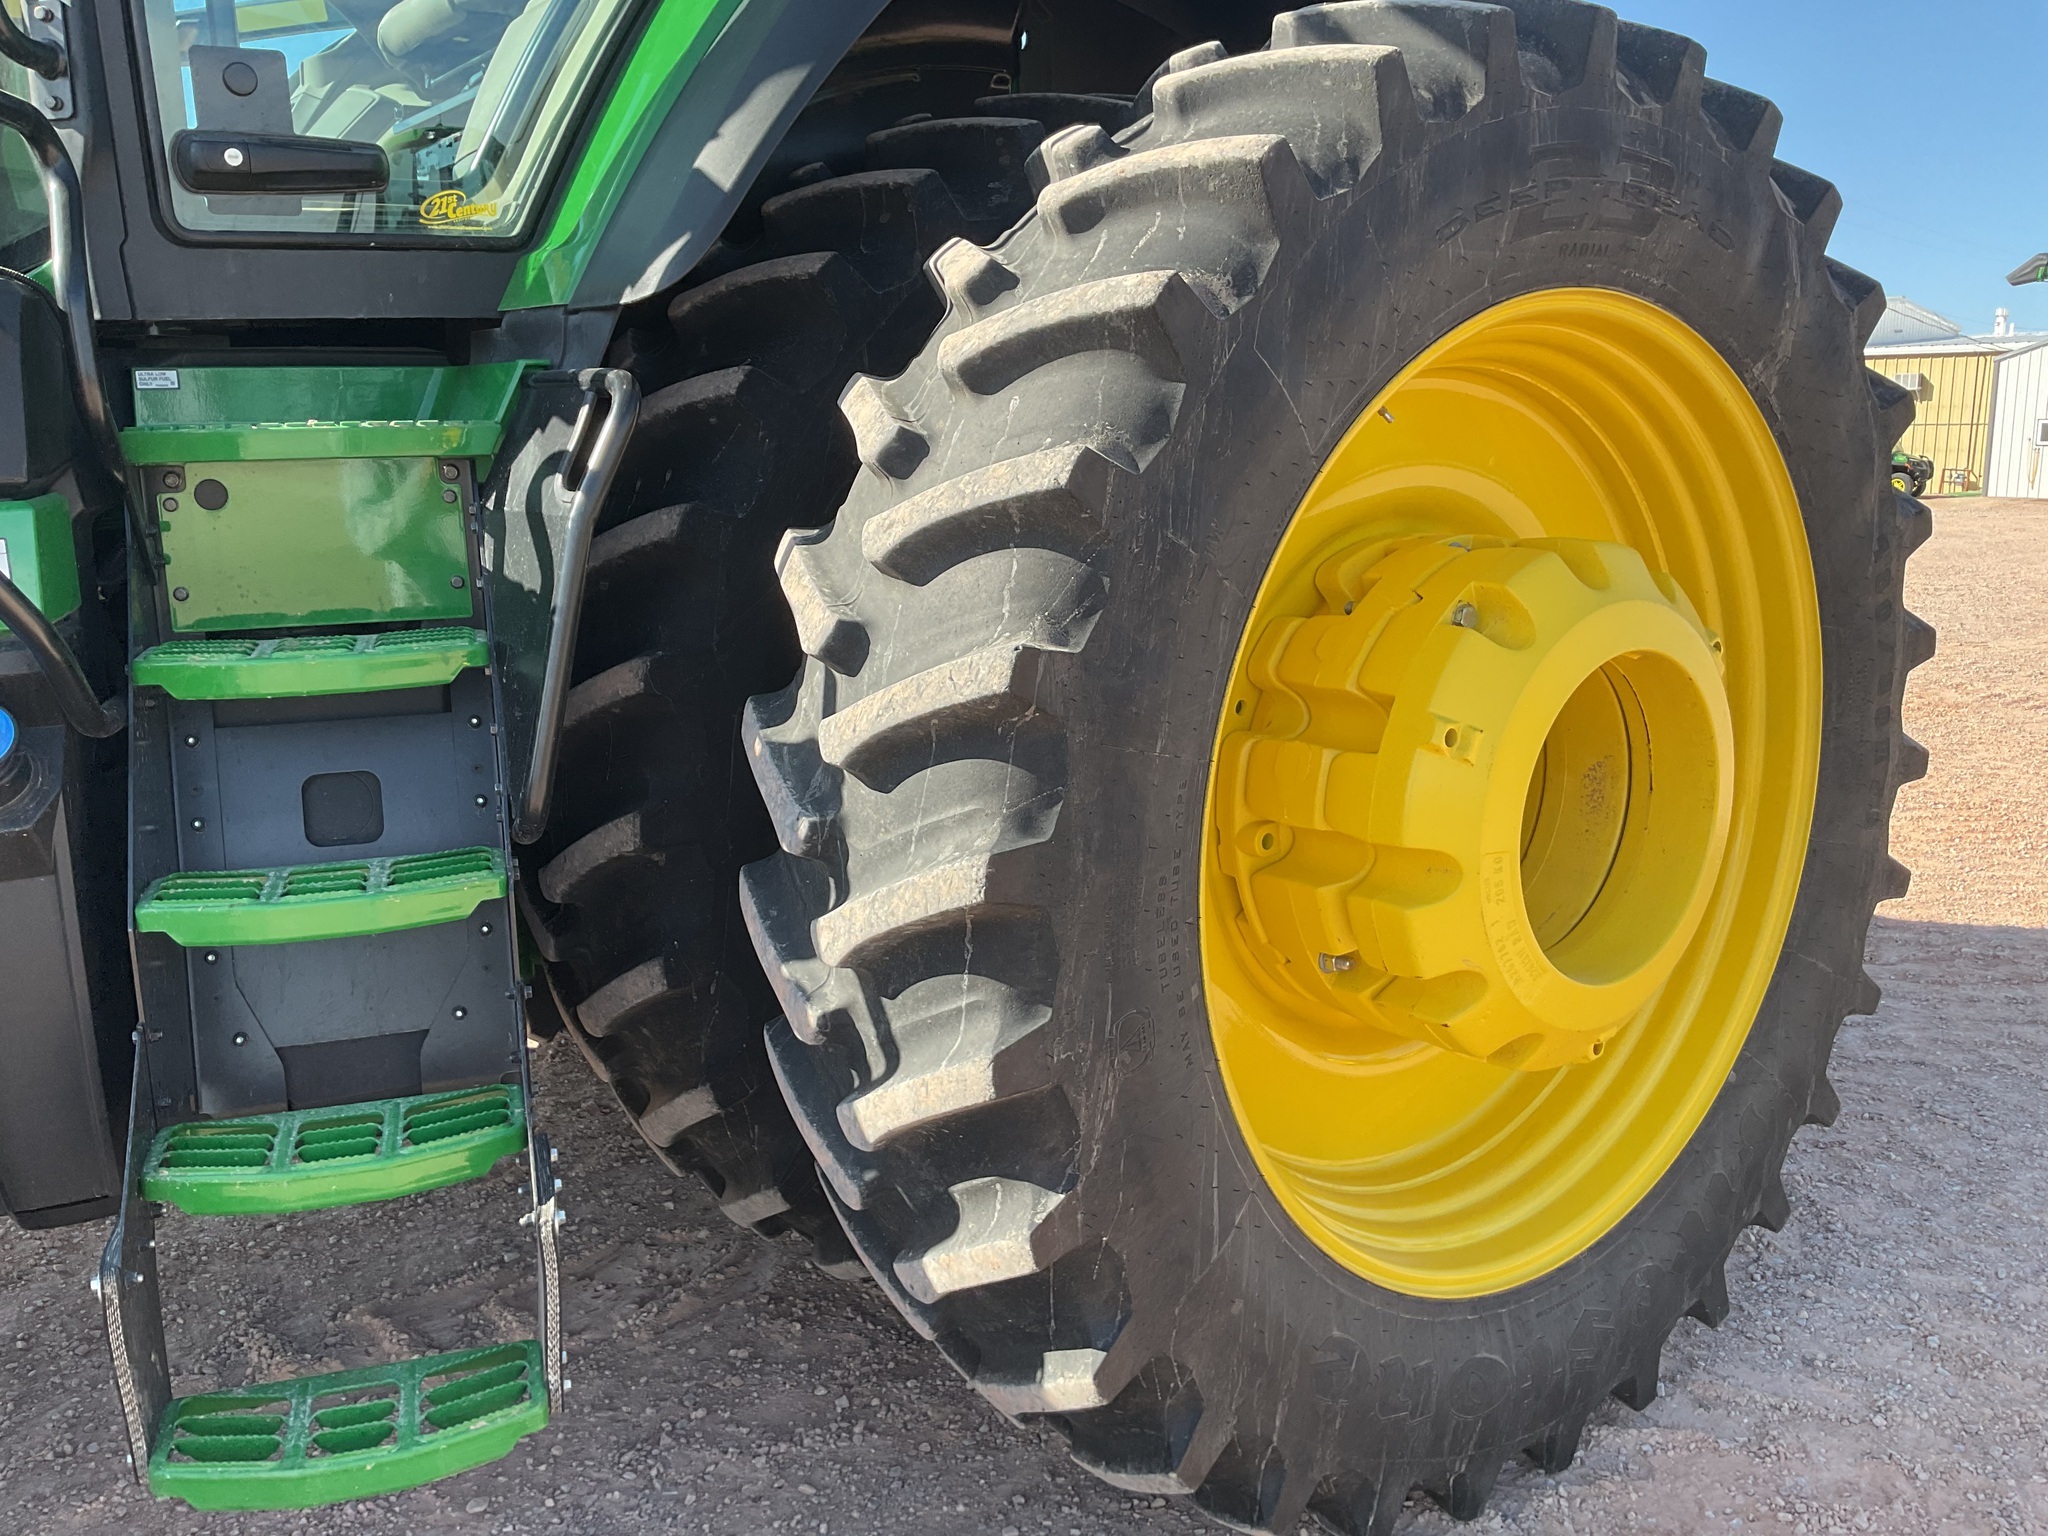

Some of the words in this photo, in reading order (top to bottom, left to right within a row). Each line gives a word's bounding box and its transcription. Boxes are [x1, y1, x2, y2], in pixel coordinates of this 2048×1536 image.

[429, 194, 458, 217] 21st
[446, 202, 498, 219] Century
[1435, 179, 1574, 249] DEEP
[1558, 243, 1611, 258] RADIAL
[1174, 779, 1188, 833] TYPE
[1170, 848, 1182, 907] TUBE
[1155, 875, 1170, 994] TUBELESS
[1170, 919, 1182, 978] USED
[1176, 990, 1187, 1019] BE
[1180, 1031, 1194, 1070] MAY
